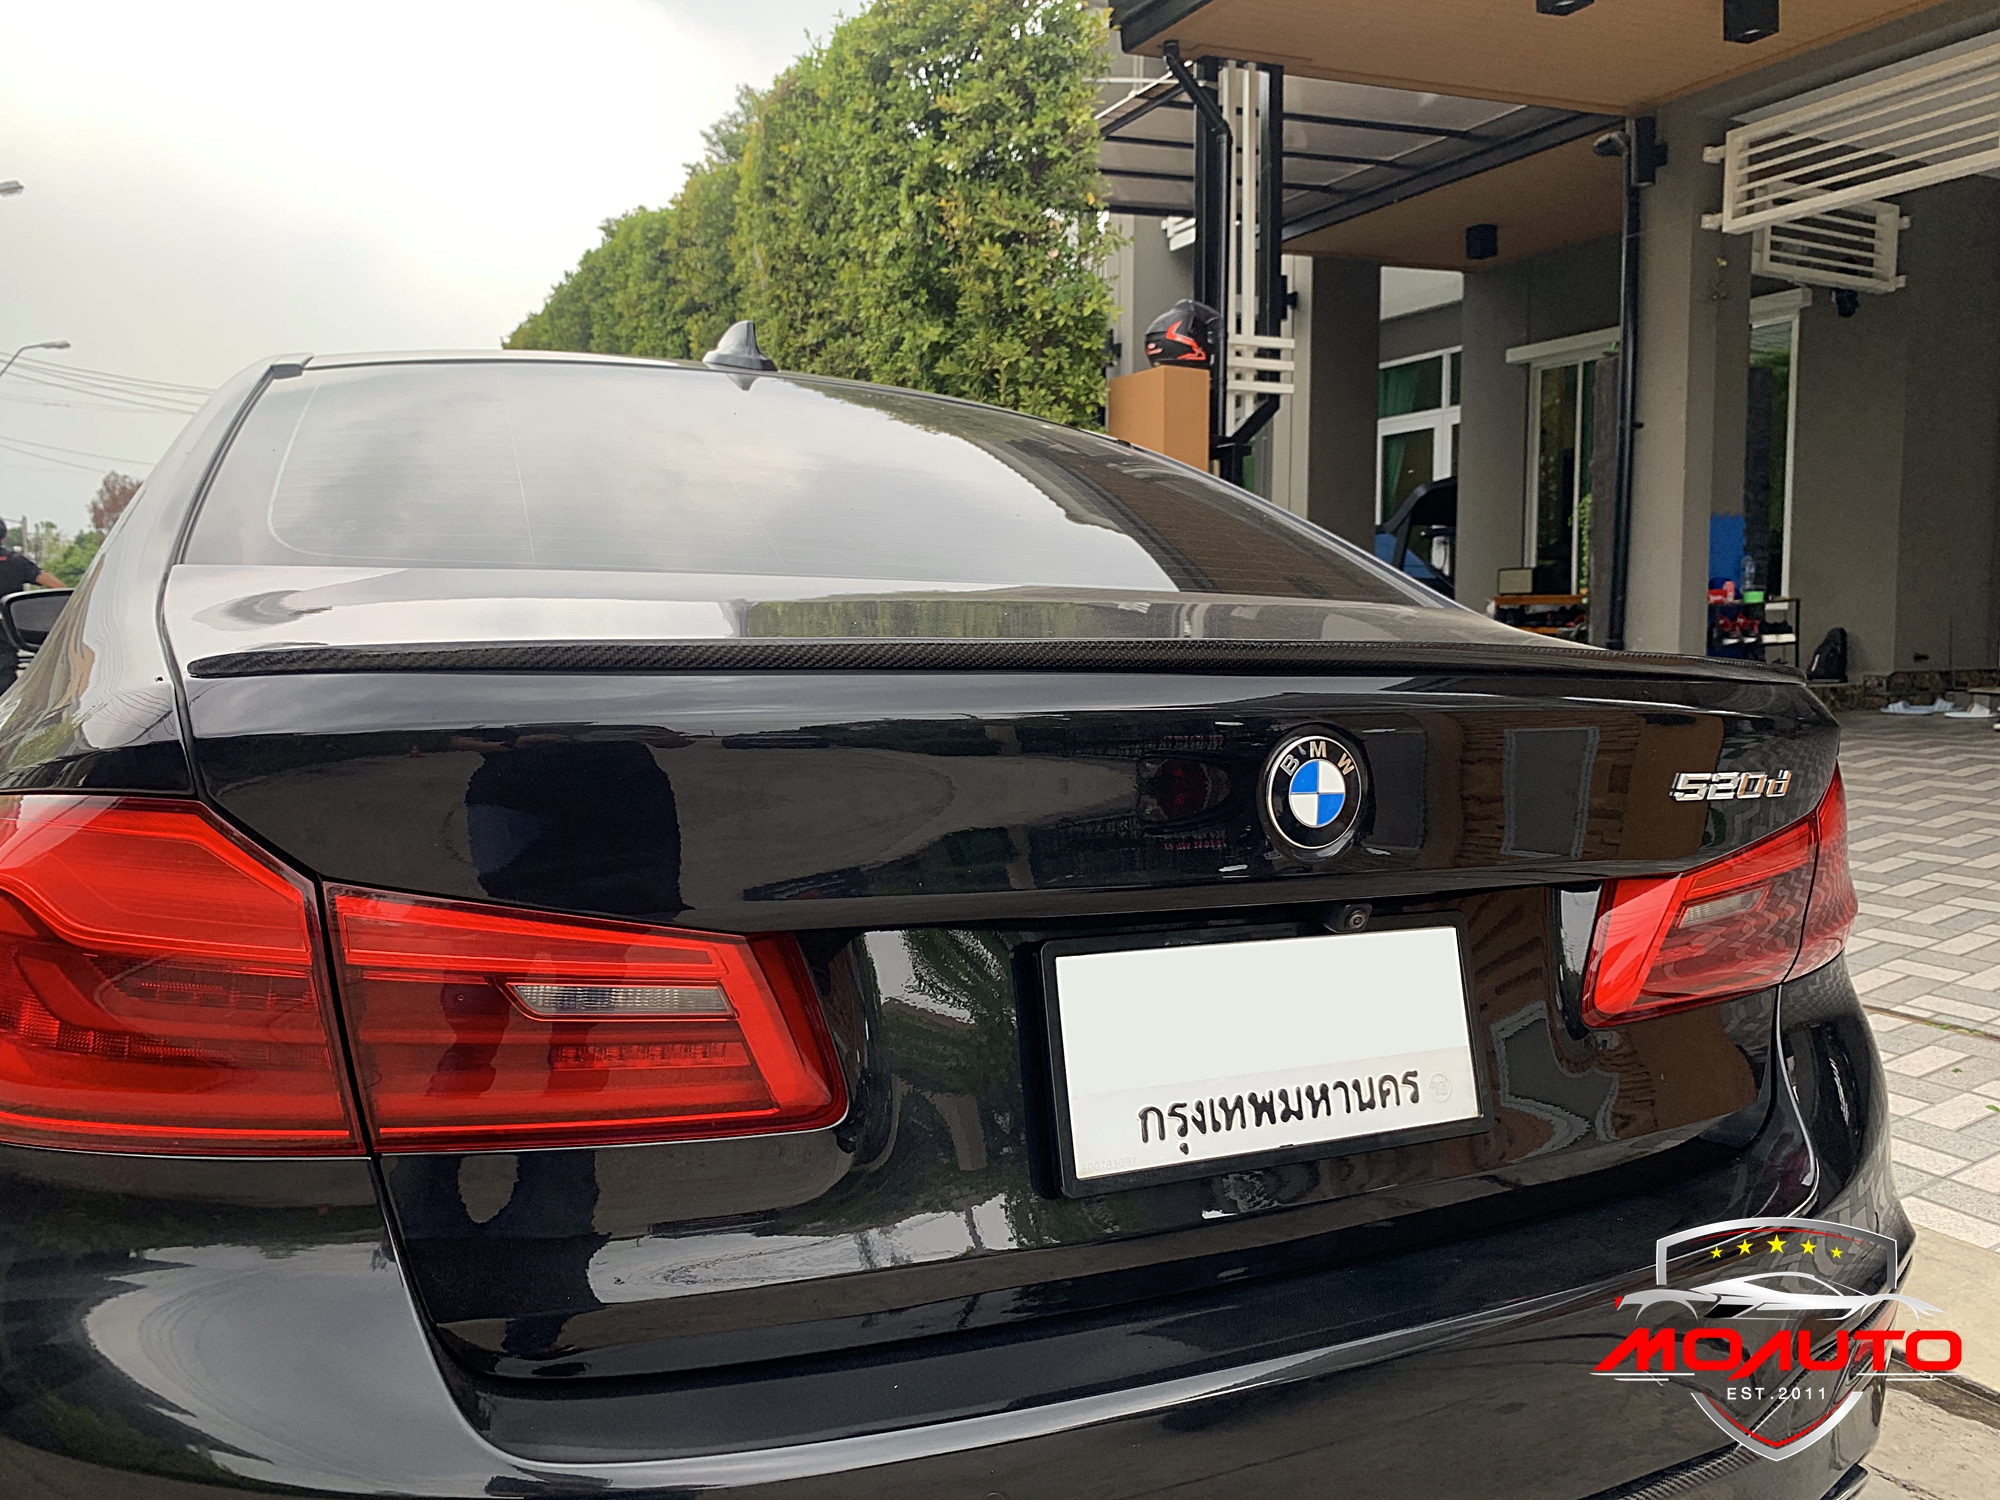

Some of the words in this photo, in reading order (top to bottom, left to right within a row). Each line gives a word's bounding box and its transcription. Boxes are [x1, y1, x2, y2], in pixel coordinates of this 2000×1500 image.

[1280, 741, 1354, 776] BMW
[1670, 770, 1792, 802] 520d
[1138, 1070, 1419, 1155] กรุงเทพมหานคร
